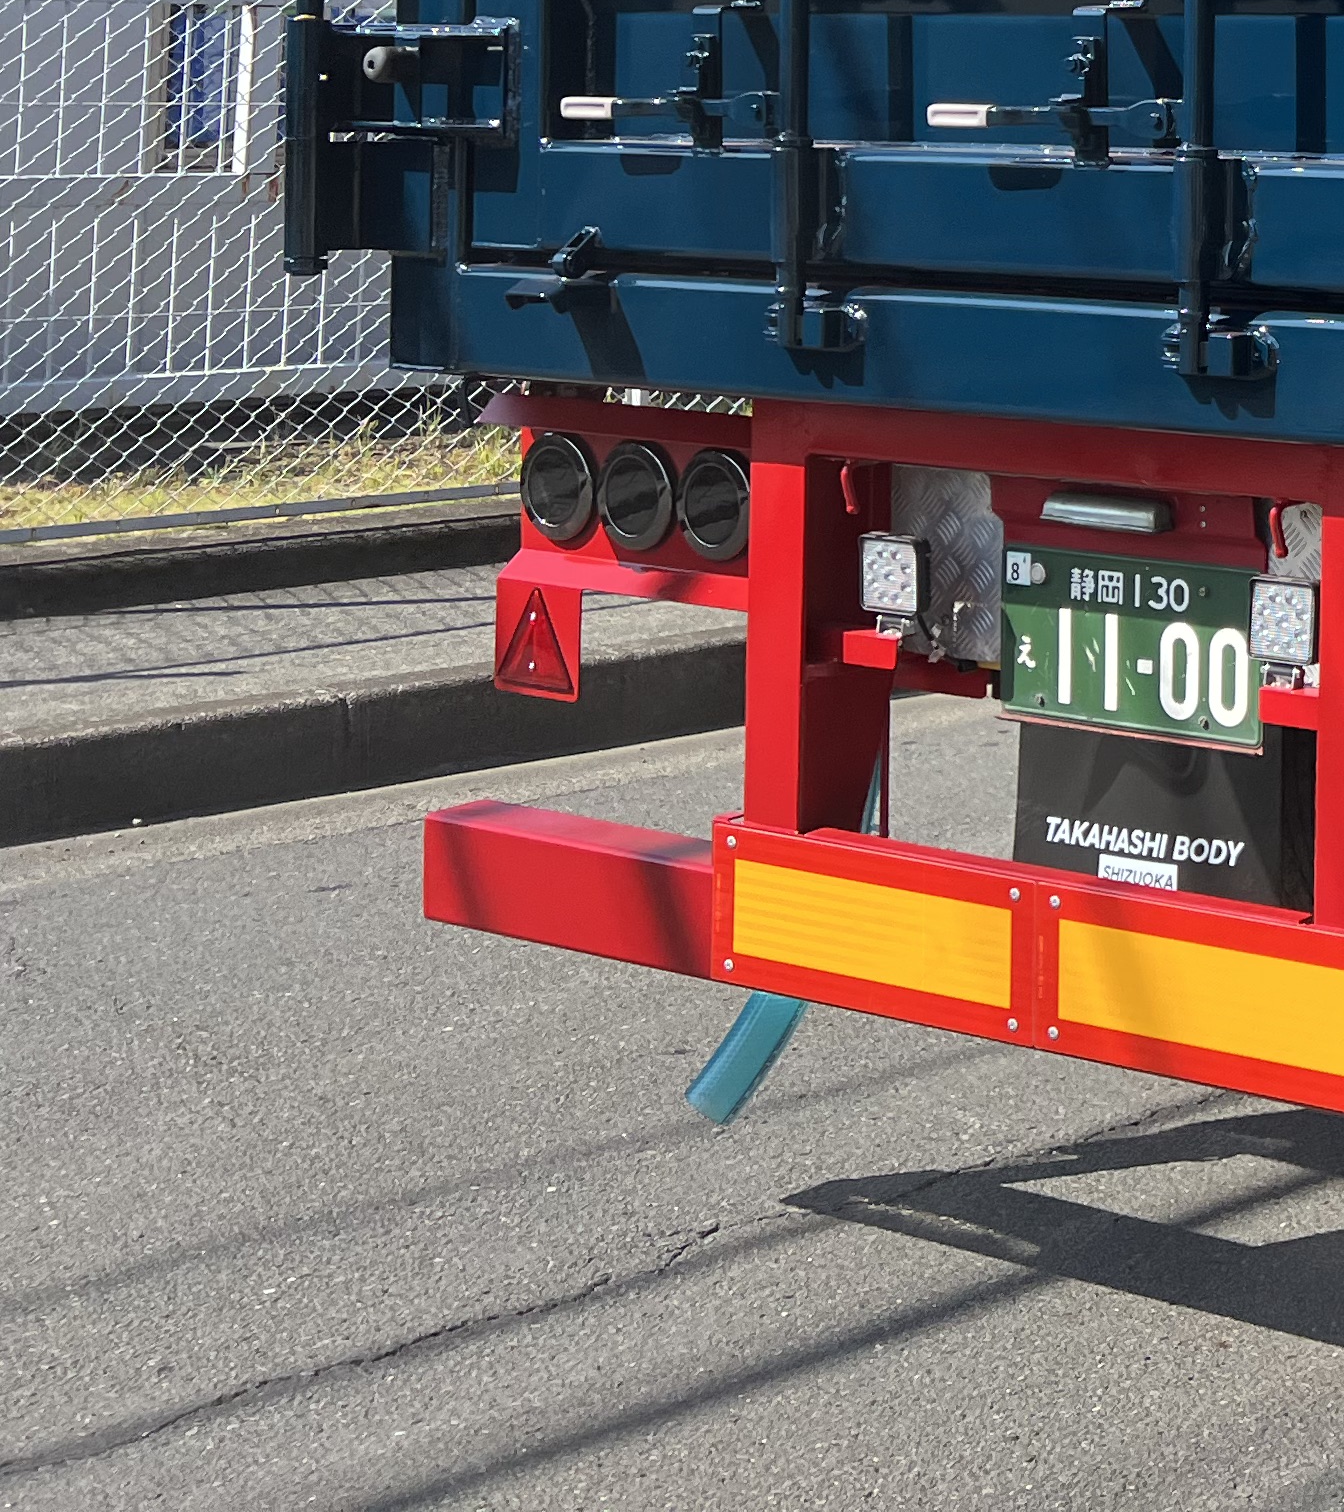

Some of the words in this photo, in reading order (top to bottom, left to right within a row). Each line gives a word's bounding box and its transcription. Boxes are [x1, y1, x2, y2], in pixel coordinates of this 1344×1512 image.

[1011, 562, 1020, 581] 8
[1070, 567, 1124, 605] 静岡
[1134, 573, 1190, 613] 130
[1017, 634, 1037, 670] え
[1057, 607, 1249, 728] 11-00
[1046, 815, 1169, 859] TAKAHASHI
[1172, 835, 1245, 867] BODY
[1103, 865, 1174, 890] SHIZUOKA
